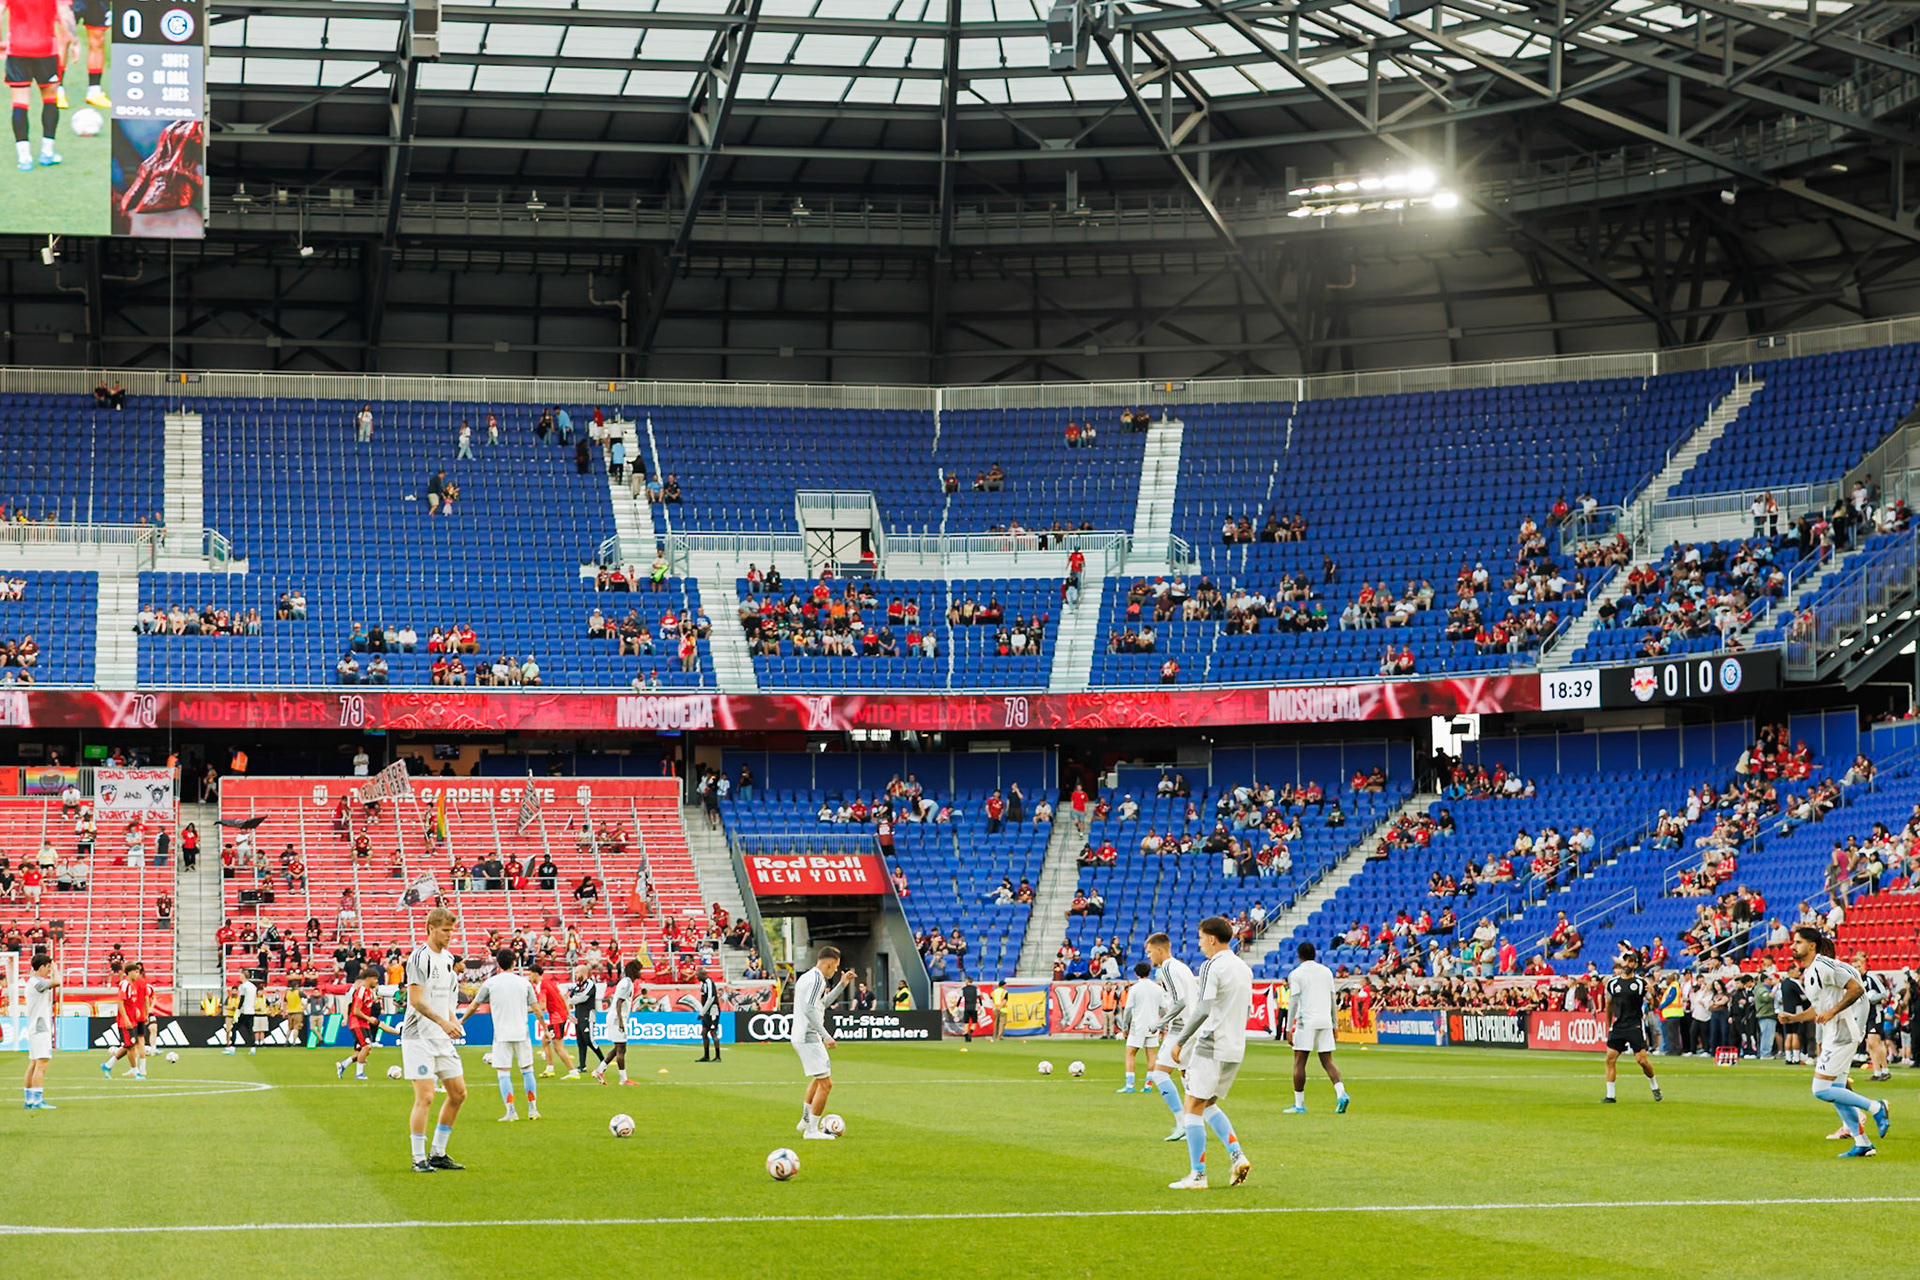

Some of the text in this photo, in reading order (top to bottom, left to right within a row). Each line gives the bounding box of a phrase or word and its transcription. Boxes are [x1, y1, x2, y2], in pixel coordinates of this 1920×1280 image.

[122, 9, 142, 38] 0
[127, 54, 144, 67] 0
[127, 71, 144, 84] 0
[127, 88, 144, 100] 0
[1664, 660, 1713, 697] 0 0
[1549, 680, 1593, 699] 18:39
[131, 694, 157, 727] 79
[178, 701, 327, 721] MIDFIELDER
[339, 694, 365, 727] 79
[616, 696, 715, 728] MOSQUERA
[808, 697, 833, 728] 79
[853, 703, 992, 724] MIDFIELDER
[1004, 697, 1029, 728] 79
[1268, 687, 1362, 722] MOSQUERA
[500, 788, 555, 804] STTE
[753, 856, 862, 869] Red Bull
[757, 869, 867, 883] NEW YORK
[833, 1015, 900, 1026] Tri-State
[1450, 1015, 1464, 1041] SI
[1463, 1016, 1477, 1041] FAN
[1537, 1019, 1561, 1041] Audi
[833, 1027, 929, 1039] Audi Dealers
